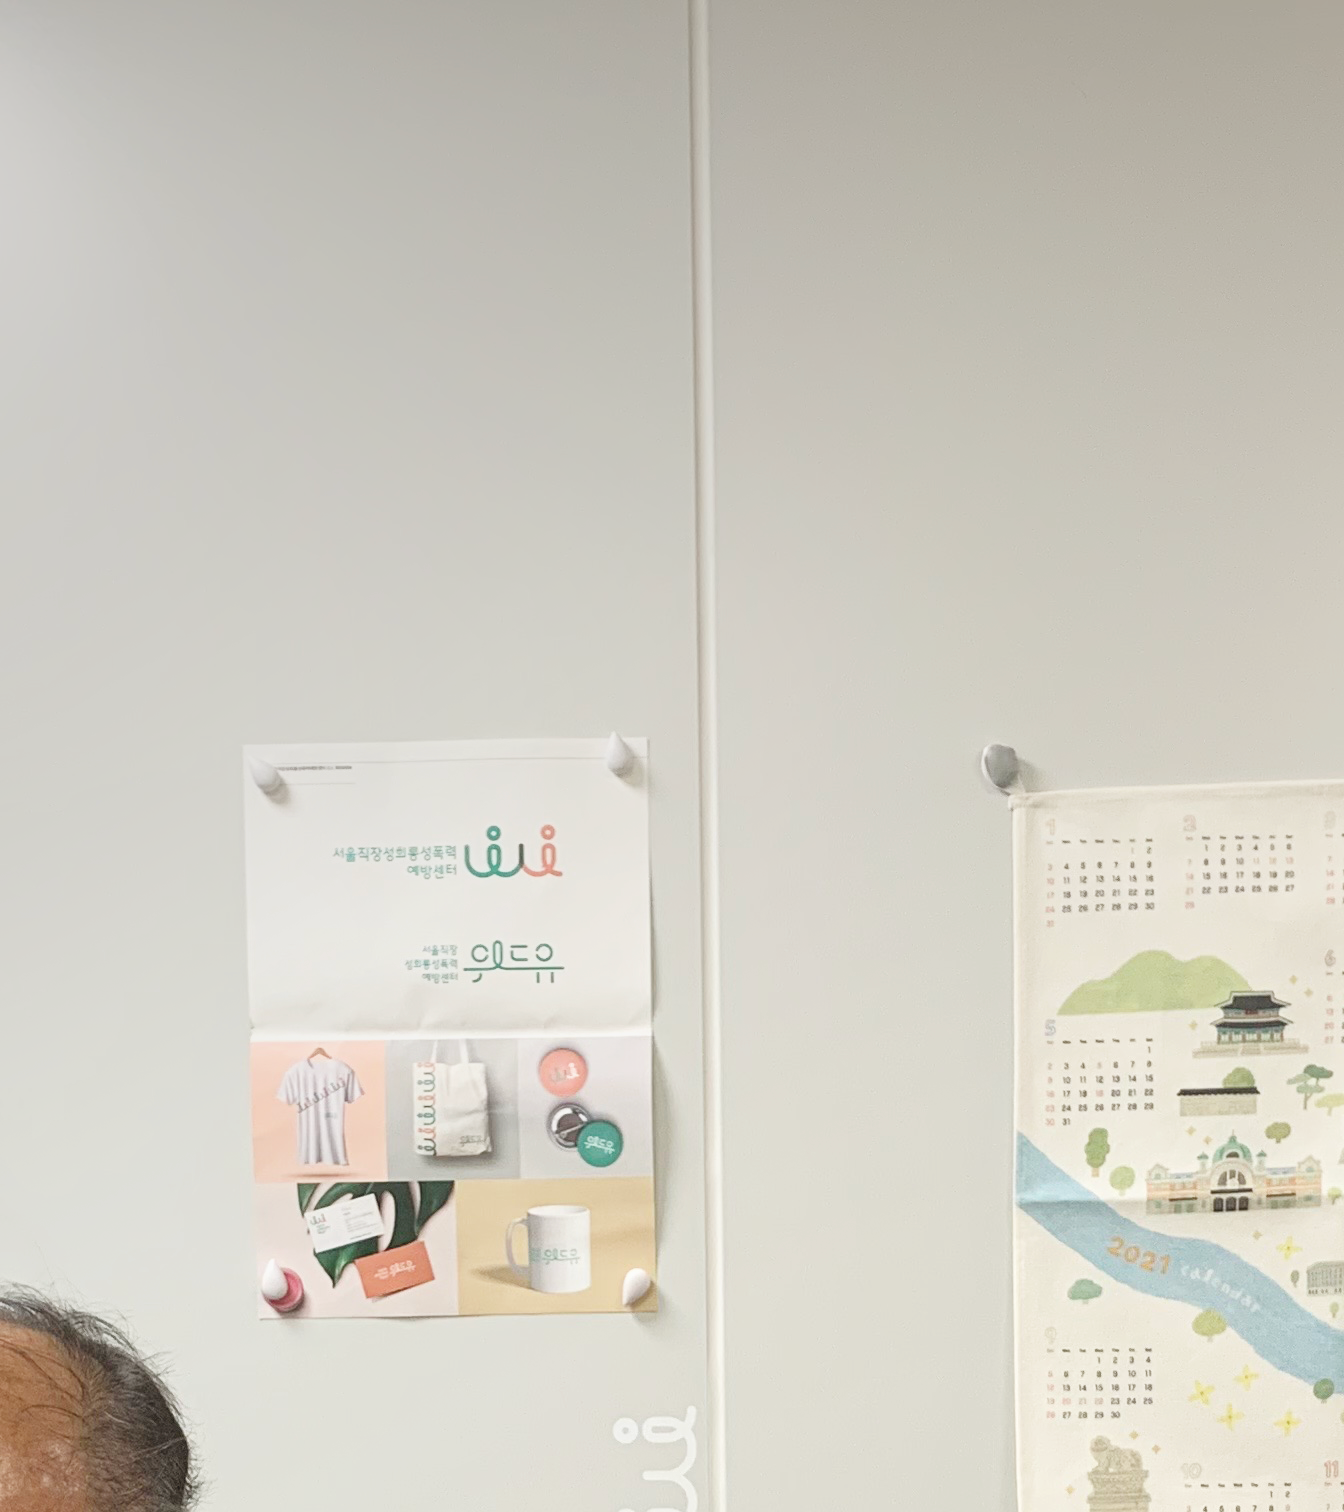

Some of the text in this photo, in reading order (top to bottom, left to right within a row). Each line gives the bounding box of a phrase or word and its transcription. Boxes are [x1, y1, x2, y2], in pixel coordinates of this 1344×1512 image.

[333, 845, 457, 862] 서울직장성희롱성폭력
[407, 864, 457, 879] 예방센터
[1063, 1076, 1071, 1084] 10
[1096, 1076, 1104, 1084] 12
[1112, 1075, 1120, 1083] 13
[1145, 1074, 1153, 1082] 15
[1108, 1236, 1261, 1312] 2021 calendar
[1129, 1356, 1134, 1364] 3
[1324, 1460, 1339, 1478] 11
